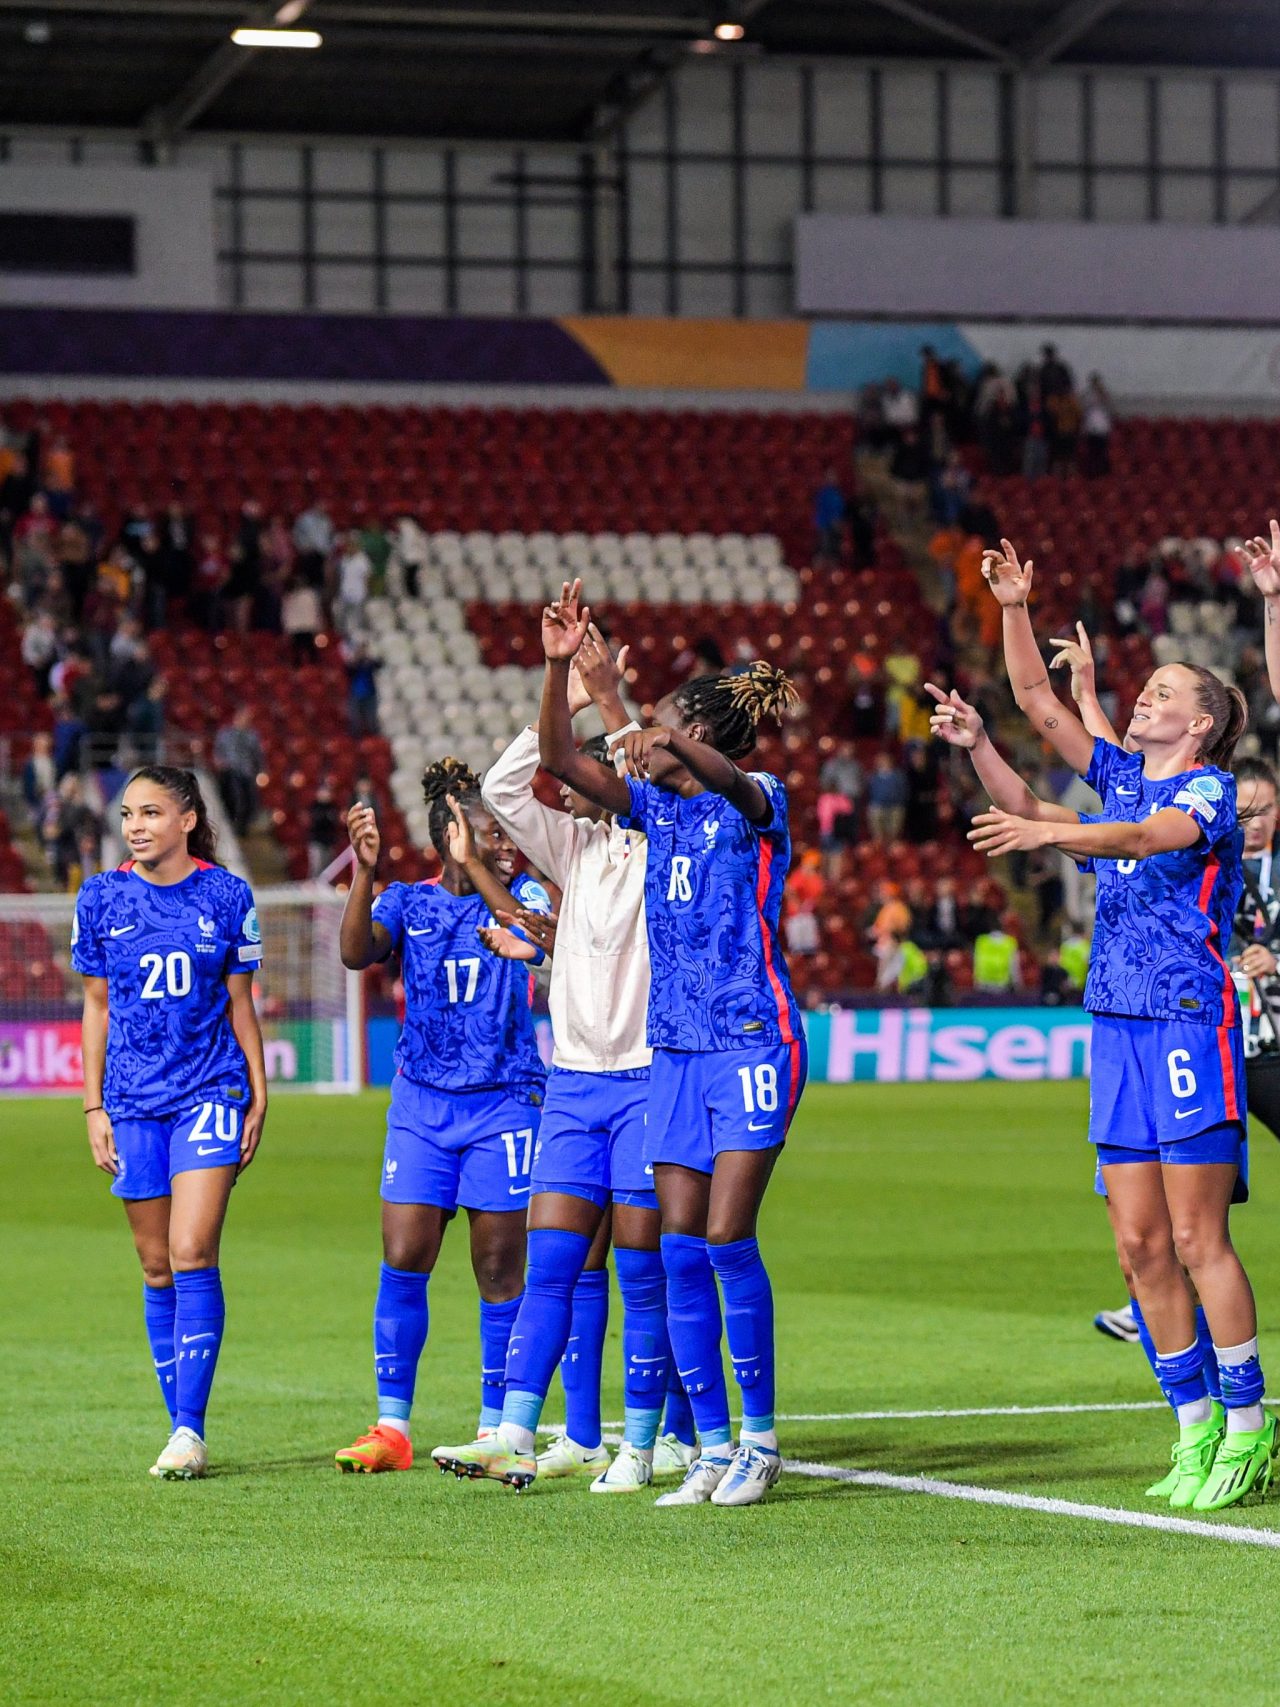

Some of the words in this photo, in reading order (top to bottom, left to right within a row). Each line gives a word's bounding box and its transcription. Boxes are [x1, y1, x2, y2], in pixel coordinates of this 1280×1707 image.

[139, 951, 191, 999] 20
[443, 957, 480, 1003] 17
[737, 1063, 778, 1113] 18
[1167, 1048, 1197, 1098] 6
[187, 1101, 238, 1142] 20
[501, 1128, 533, 1178] 17
